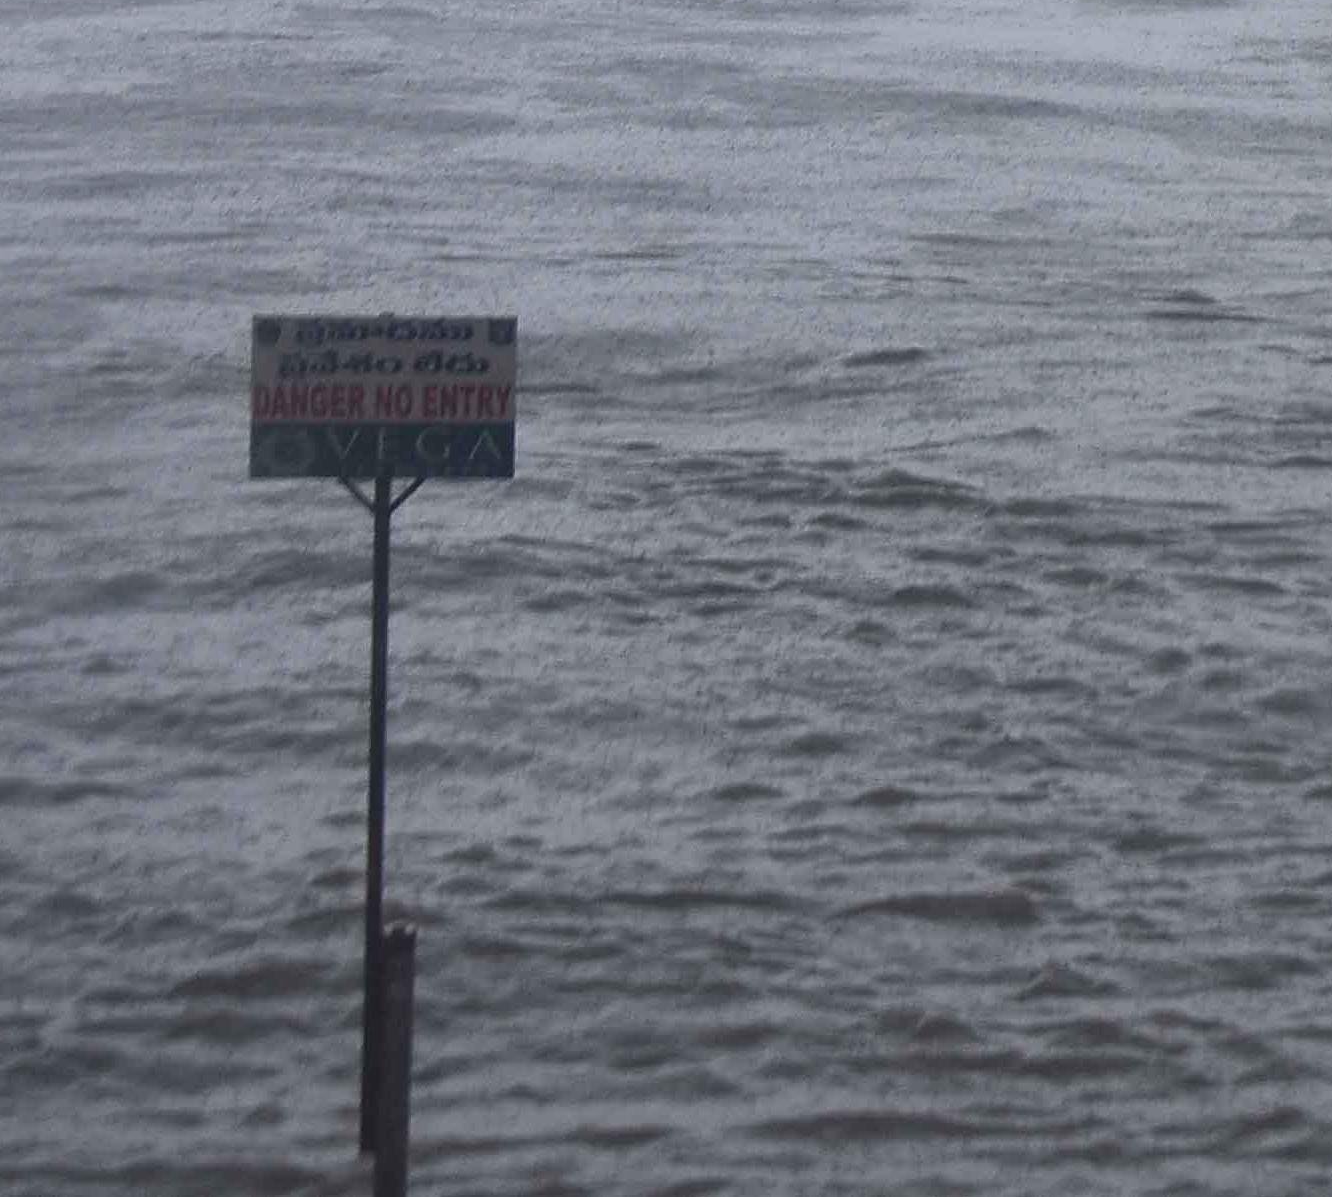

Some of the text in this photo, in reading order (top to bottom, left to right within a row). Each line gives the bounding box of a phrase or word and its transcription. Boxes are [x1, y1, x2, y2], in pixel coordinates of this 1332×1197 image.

[253, 382, 512, 419] DANGER NO ENTRY
